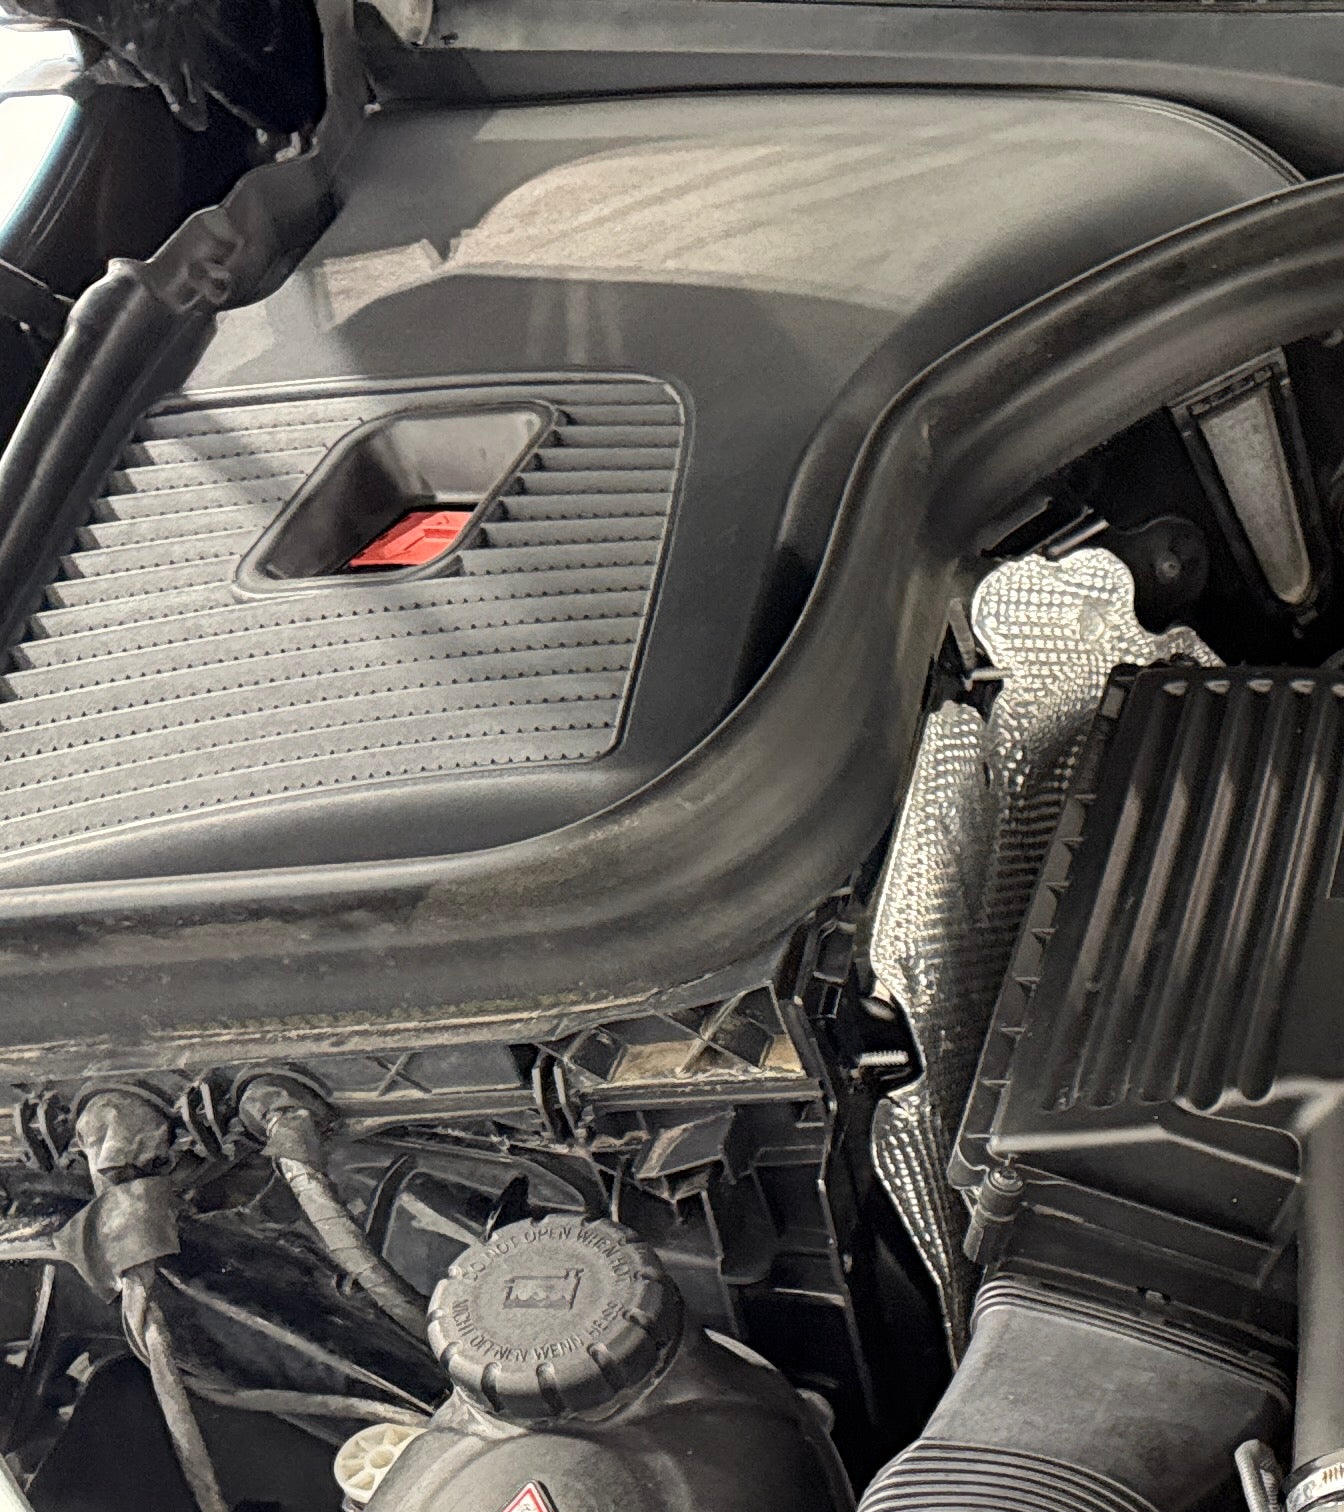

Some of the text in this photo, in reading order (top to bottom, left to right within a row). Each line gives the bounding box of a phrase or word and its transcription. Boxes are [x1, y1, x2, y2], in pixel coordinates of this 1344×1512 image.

[462, 1261, 487, 1282] DO
[484, 1235, 519, 1264] NOT
[524, 1226, 572, 1243] OPEN
[576, 1228, 620, 1259] WHEN
[452, 1299, 478, 1338] NICHT
[534, 1335, 585, 1361] WENN
